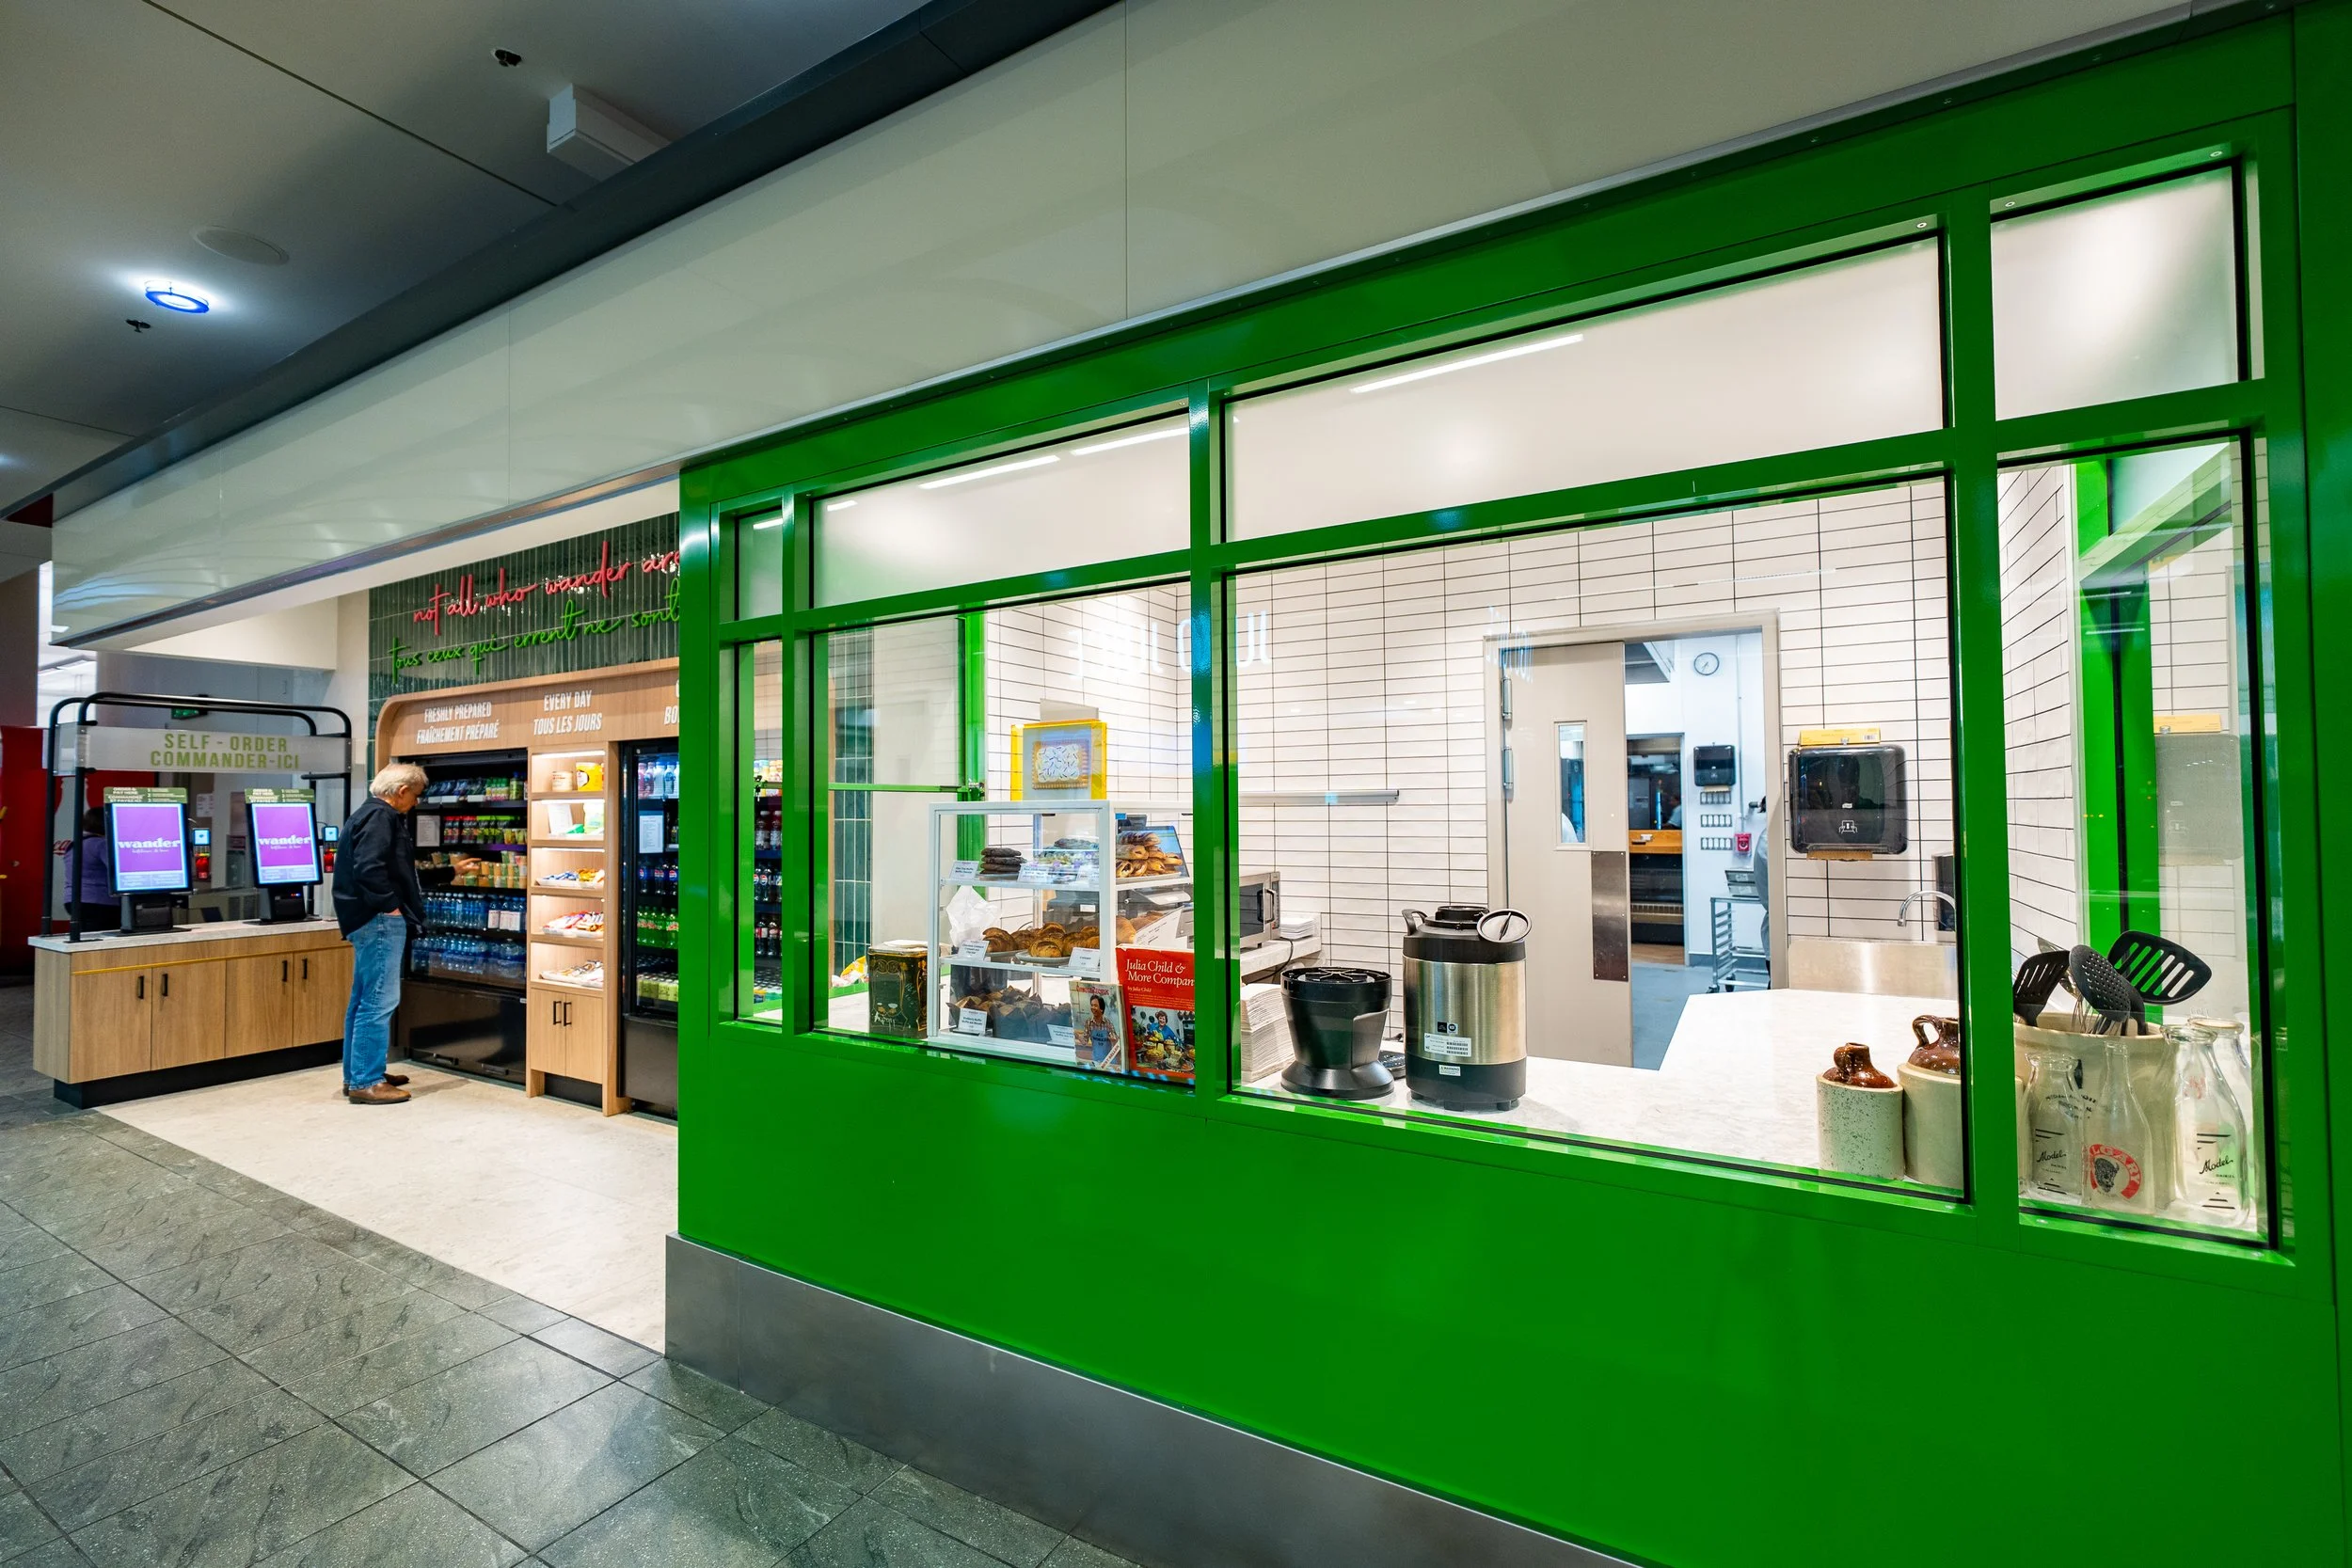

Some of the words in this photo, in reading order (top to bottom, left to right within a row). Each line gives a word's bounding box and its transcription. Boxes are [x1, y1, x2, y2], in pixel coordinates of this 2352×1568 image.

[414, 583, 451, 636] not
[447, 574, 480, 617] all
[485, 567, 539, 608] who
[545, 541, 632, 598] wander
[427, 646, 466, 663] ceux
[469, 633, 509, 675] qui
[514, 599, 589, 645] errent
[583, 620, 625, 636] ne
[631, 578, 679, 627] sont
[543, 691, 572, 712] EVERY
[574, 689, 593, 708] DAY
[424, 705, 453, 723] FRESHLY
[454, 701, 492, 721] PREPARED
[416, 725, 465, 745] FRAÎCHEMENT
[465, 719, 500, 741] PRÉPARÉ
[533, 717, 555, 736] TOUS
[556, 715, 573, 734] LES
[574, 712, 603, 732] JOURS
[165, 733, 211, 750] SELF
[230, 736, 287, 752] ORDER
[151, 751, 299, 769] COMMANDER-ICI
[118, 837, 181, 848] wander
[259, 834, 311, 845] wander
[1125, 959, 1146, 972] Julia
[1148, 960, 1173, 973] Child
[1175, 962, 1185, 974] &
[1128, 971, 1152, 983] More
[2036, 1149, 2066, 1163] Model
[2200, 1155, 2233, 1174] Model
